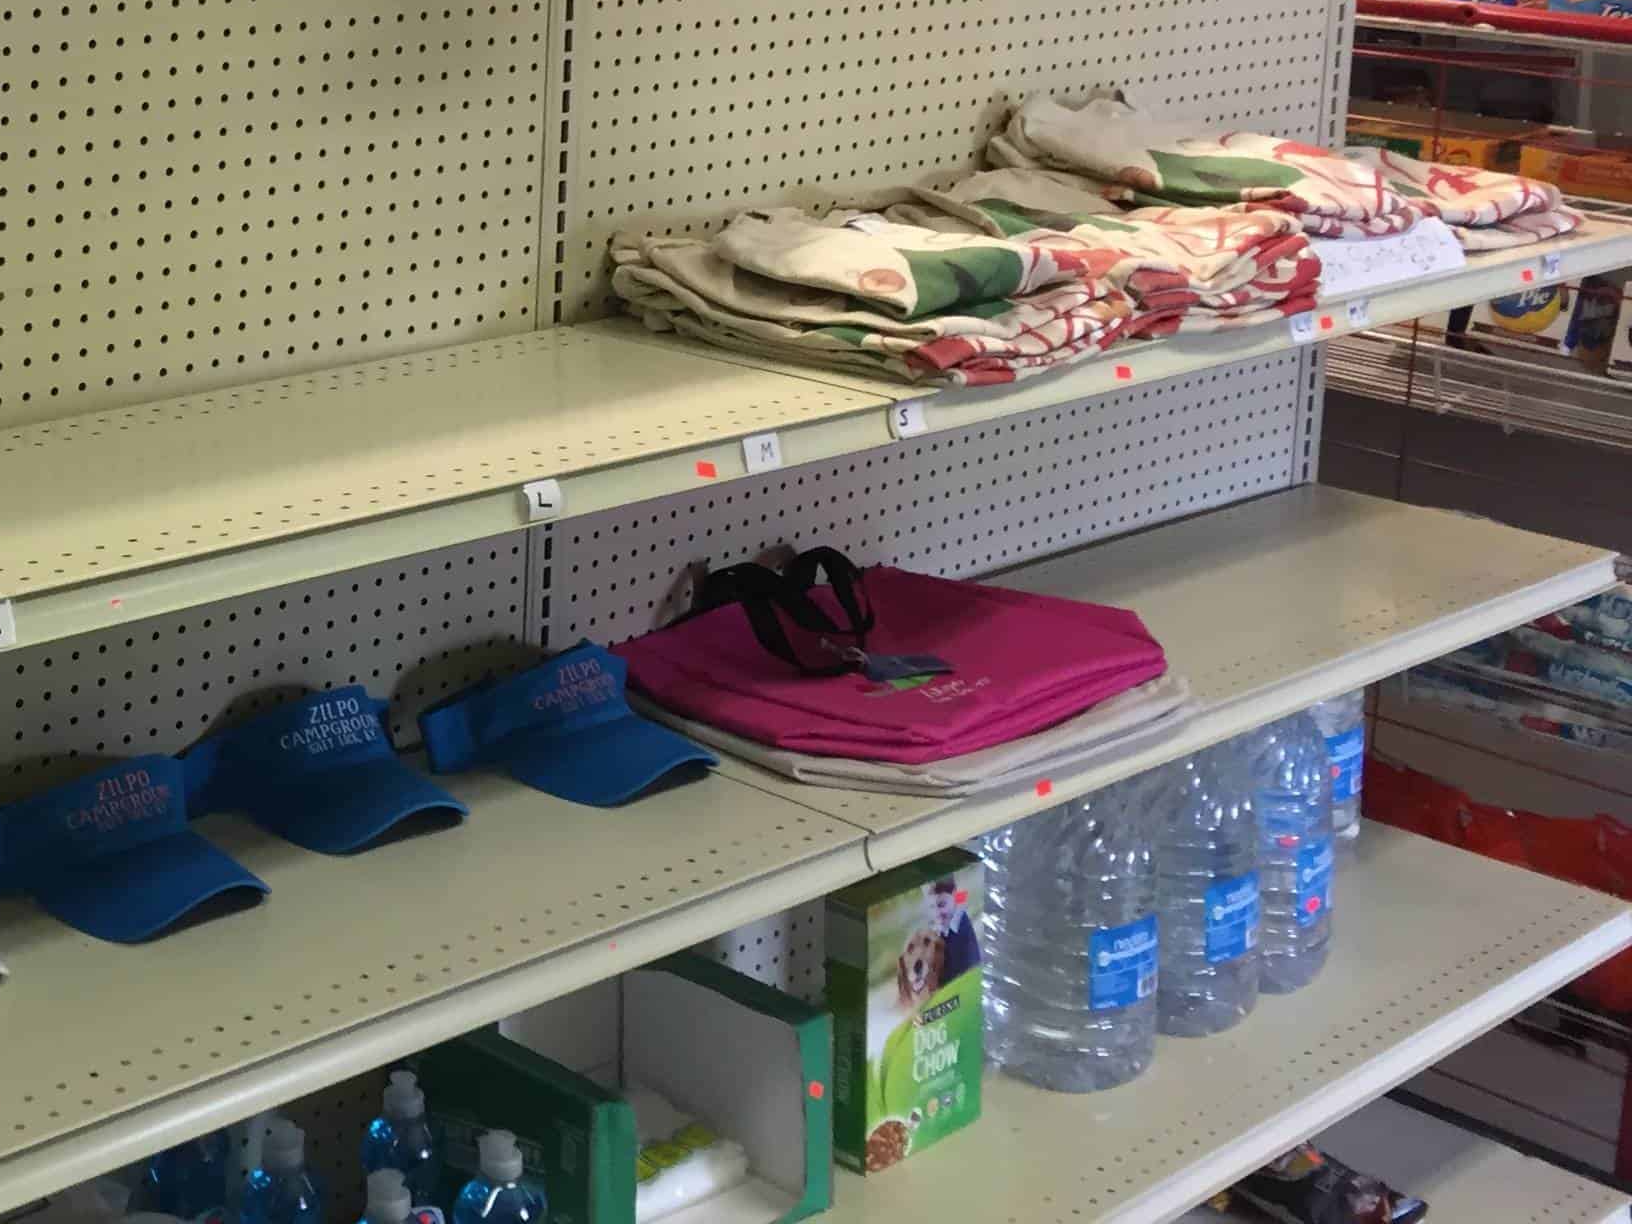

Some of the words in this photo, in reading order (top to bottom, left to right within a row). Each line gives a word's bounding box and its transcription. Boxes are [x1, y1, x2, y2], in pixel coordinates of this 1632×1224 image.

[898, 408, 909, 426] S
[760, 441, 774, 459] M
[536, 491, 553, 508] L
[309, 697, 360, 724] ZILPO
[279, 713, 380, 750] CAMPGROUN
[96, 769, 150, 802] ZILPO
[913, 1022, 948, 1055] DOG
[912, 1039, 961, 1083] CHOW
